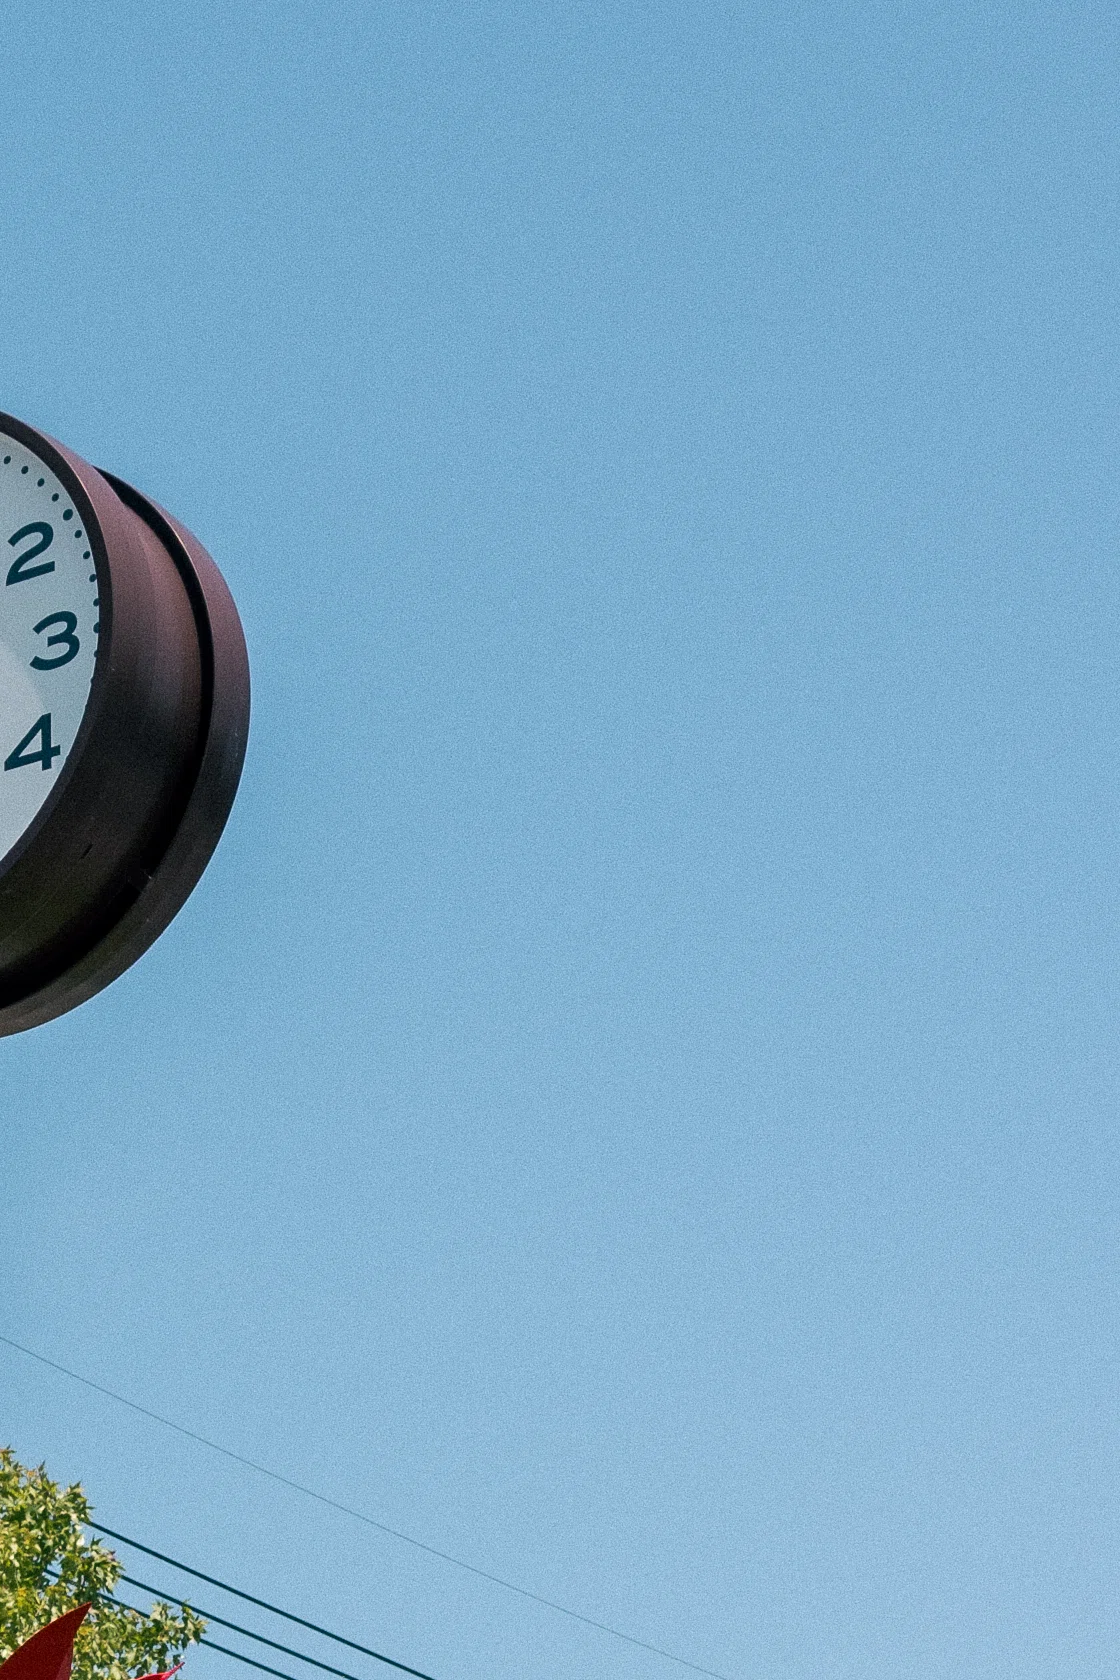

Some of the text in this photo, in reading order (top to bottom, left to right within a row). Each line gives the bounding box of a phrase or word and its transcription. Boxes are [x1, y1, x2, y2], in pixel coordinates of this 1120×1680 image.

[6, 521, 56, 586] 2
[30, 611, 81, 672] 3
[4, 713, 61, 771] 4
